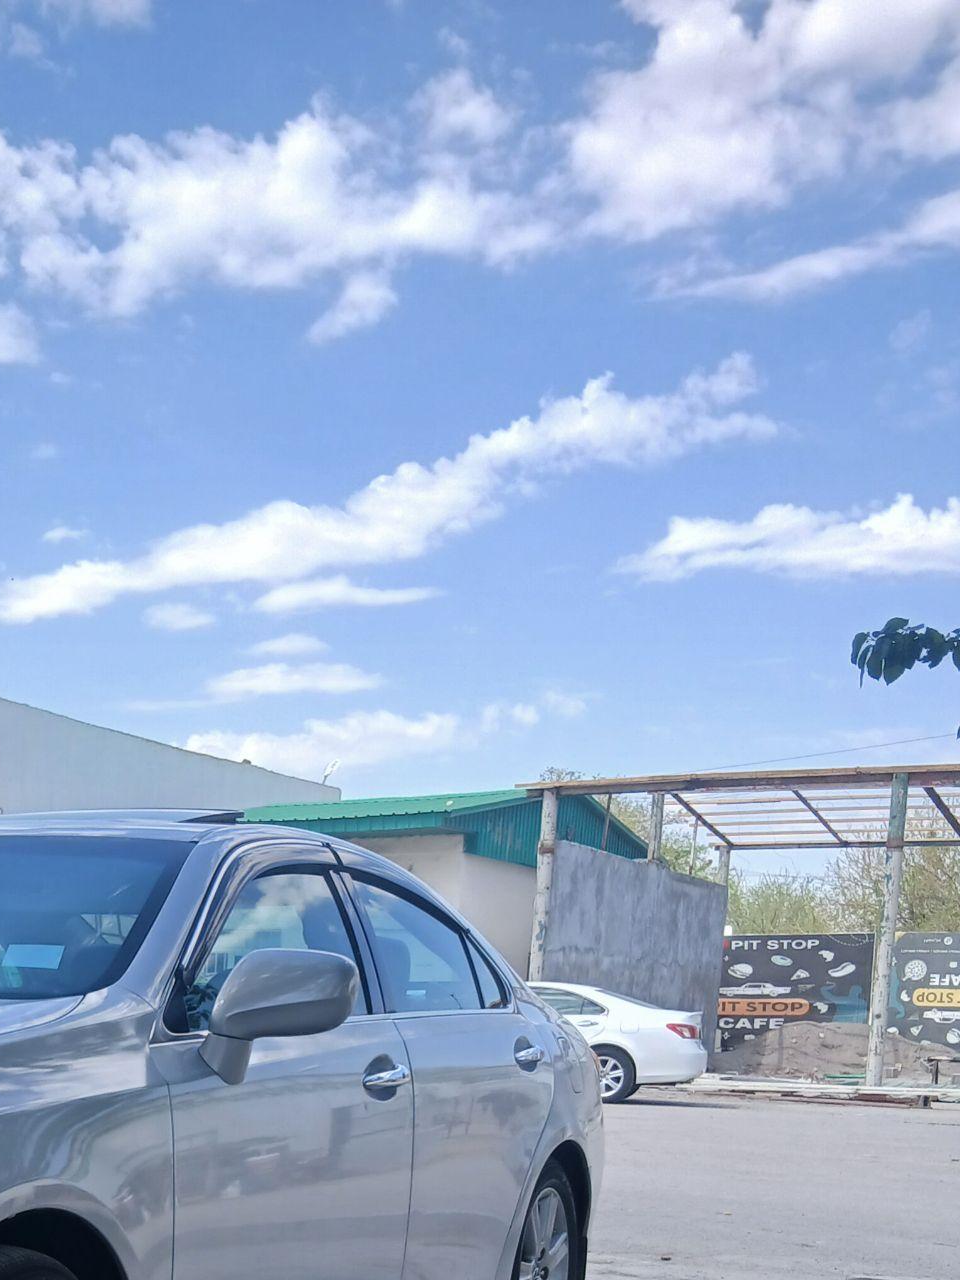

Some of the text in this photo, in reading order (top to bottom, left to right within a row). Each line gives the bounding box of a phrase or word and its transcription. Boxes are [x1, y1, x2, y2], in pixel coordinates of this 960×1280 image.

[731, 939, 820, 950] PIT STOP
[916, 992, 954, 1003] STOP
[718, 1001, 803, 1012] IT STOP
[718, 1018, 784, 1029] CAFE
